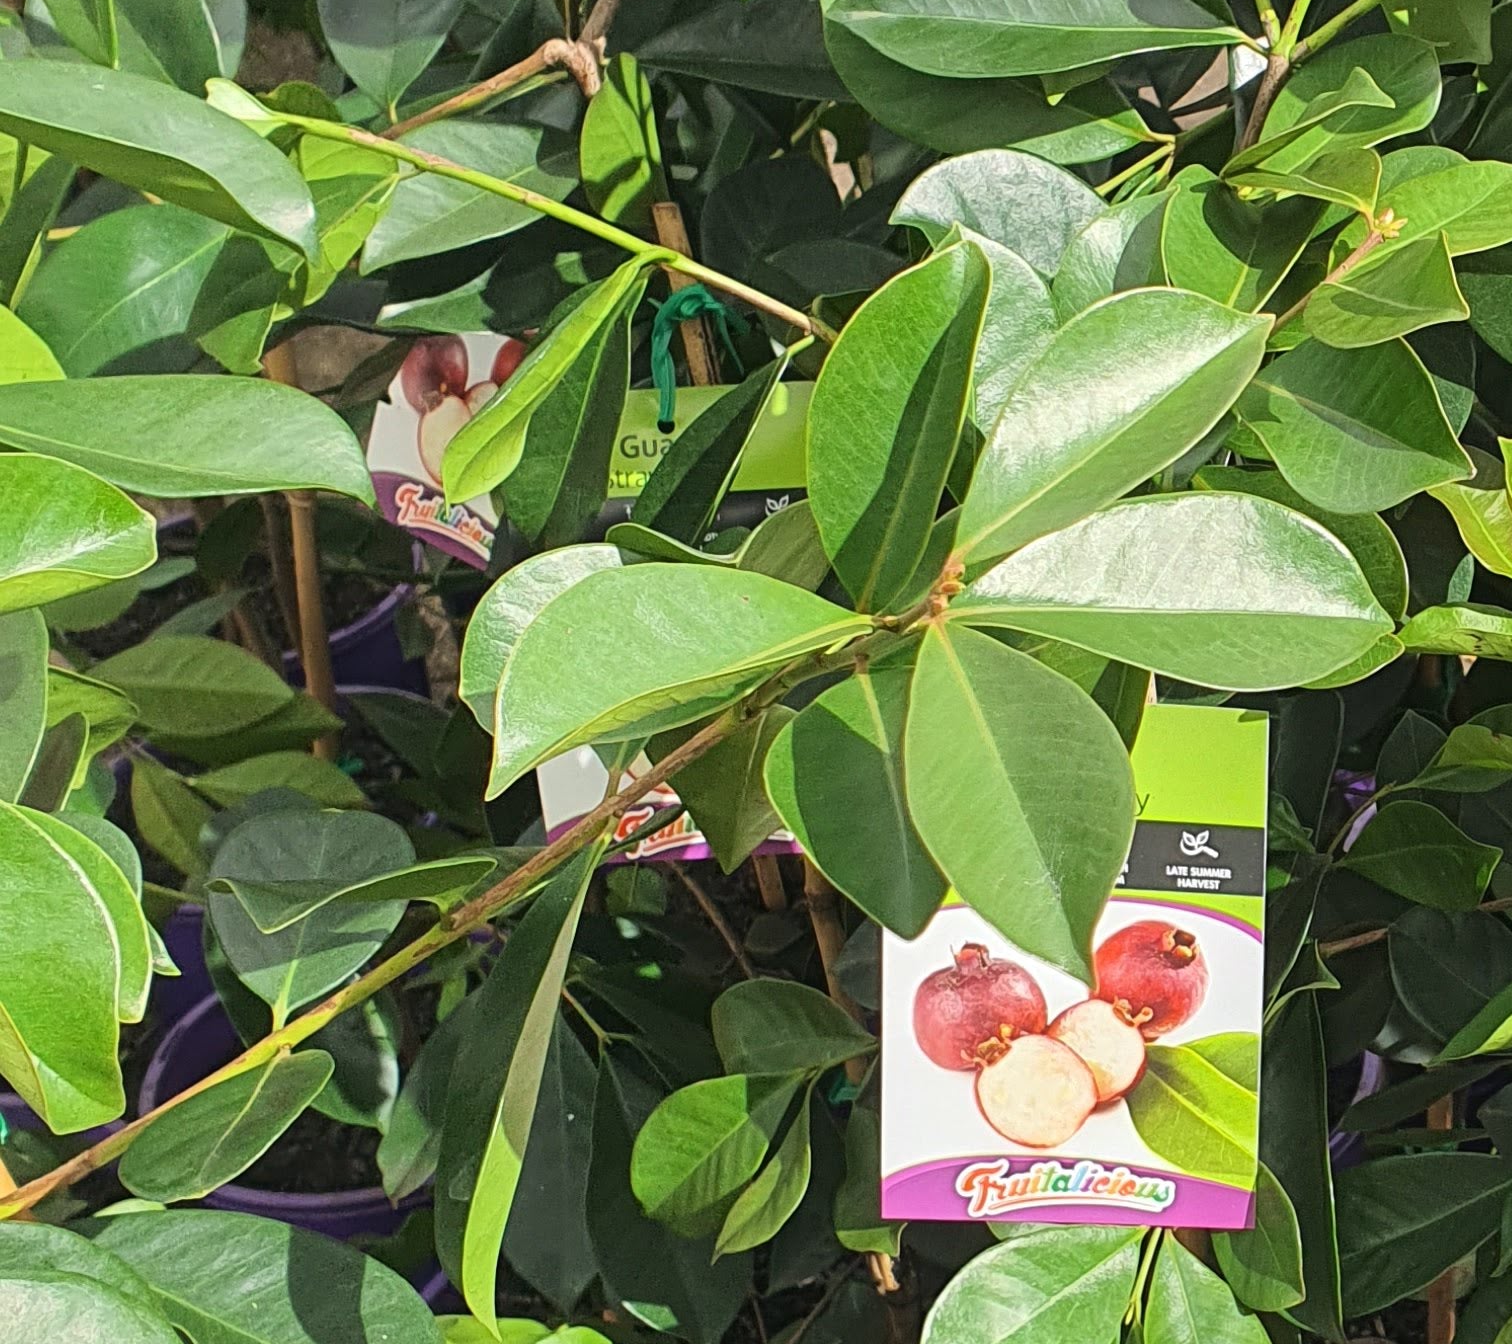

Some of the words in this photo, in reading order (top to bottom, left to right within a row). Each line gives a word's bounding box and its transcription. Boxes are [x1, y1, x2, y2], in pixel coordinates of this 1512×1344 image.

[619, 435, 673, 459] Gua
[396, 484, 493, 550] Fruitaliciou
[1165, 865, 1189, 877] LATE
[1190, 866, 1232, 880] SUMMER
[1177, 877, 1221, 891] HARVEST
[959, 1161, 1172, 1214] Fruitalicious
